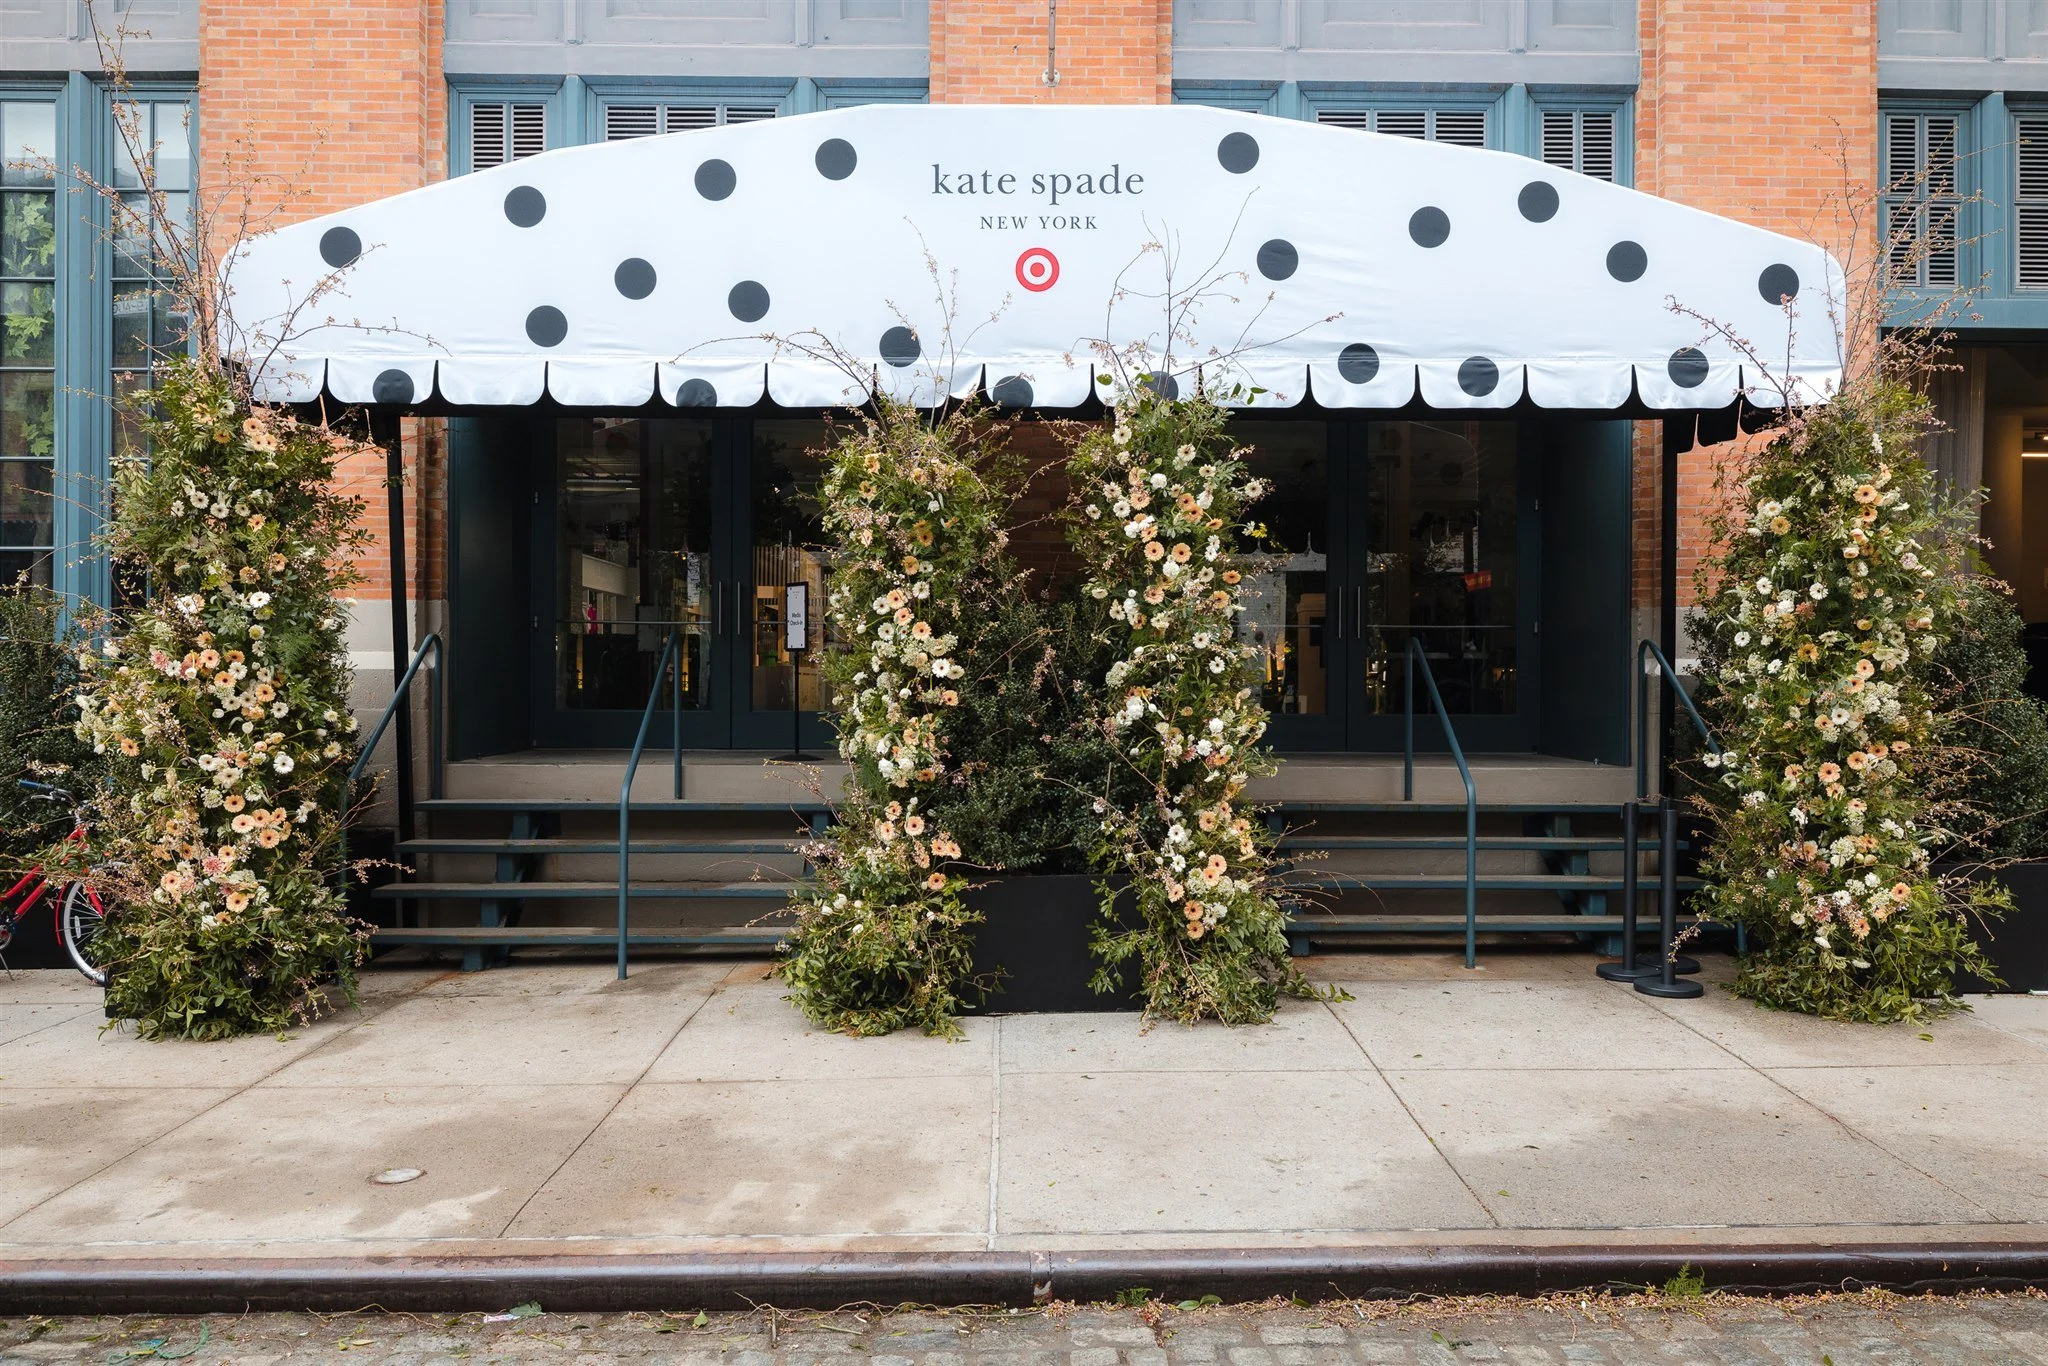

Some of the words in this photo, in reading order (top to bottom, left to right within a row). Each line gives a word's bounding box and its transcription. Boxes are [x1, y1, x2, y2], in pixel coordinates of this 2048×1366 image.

[932, 163, 1017, 195] kate
[1031, 163, 1145, 206] spade
[980, 215, 1028, 230] NEW
[1039, 215, 1098, 230] YORK
